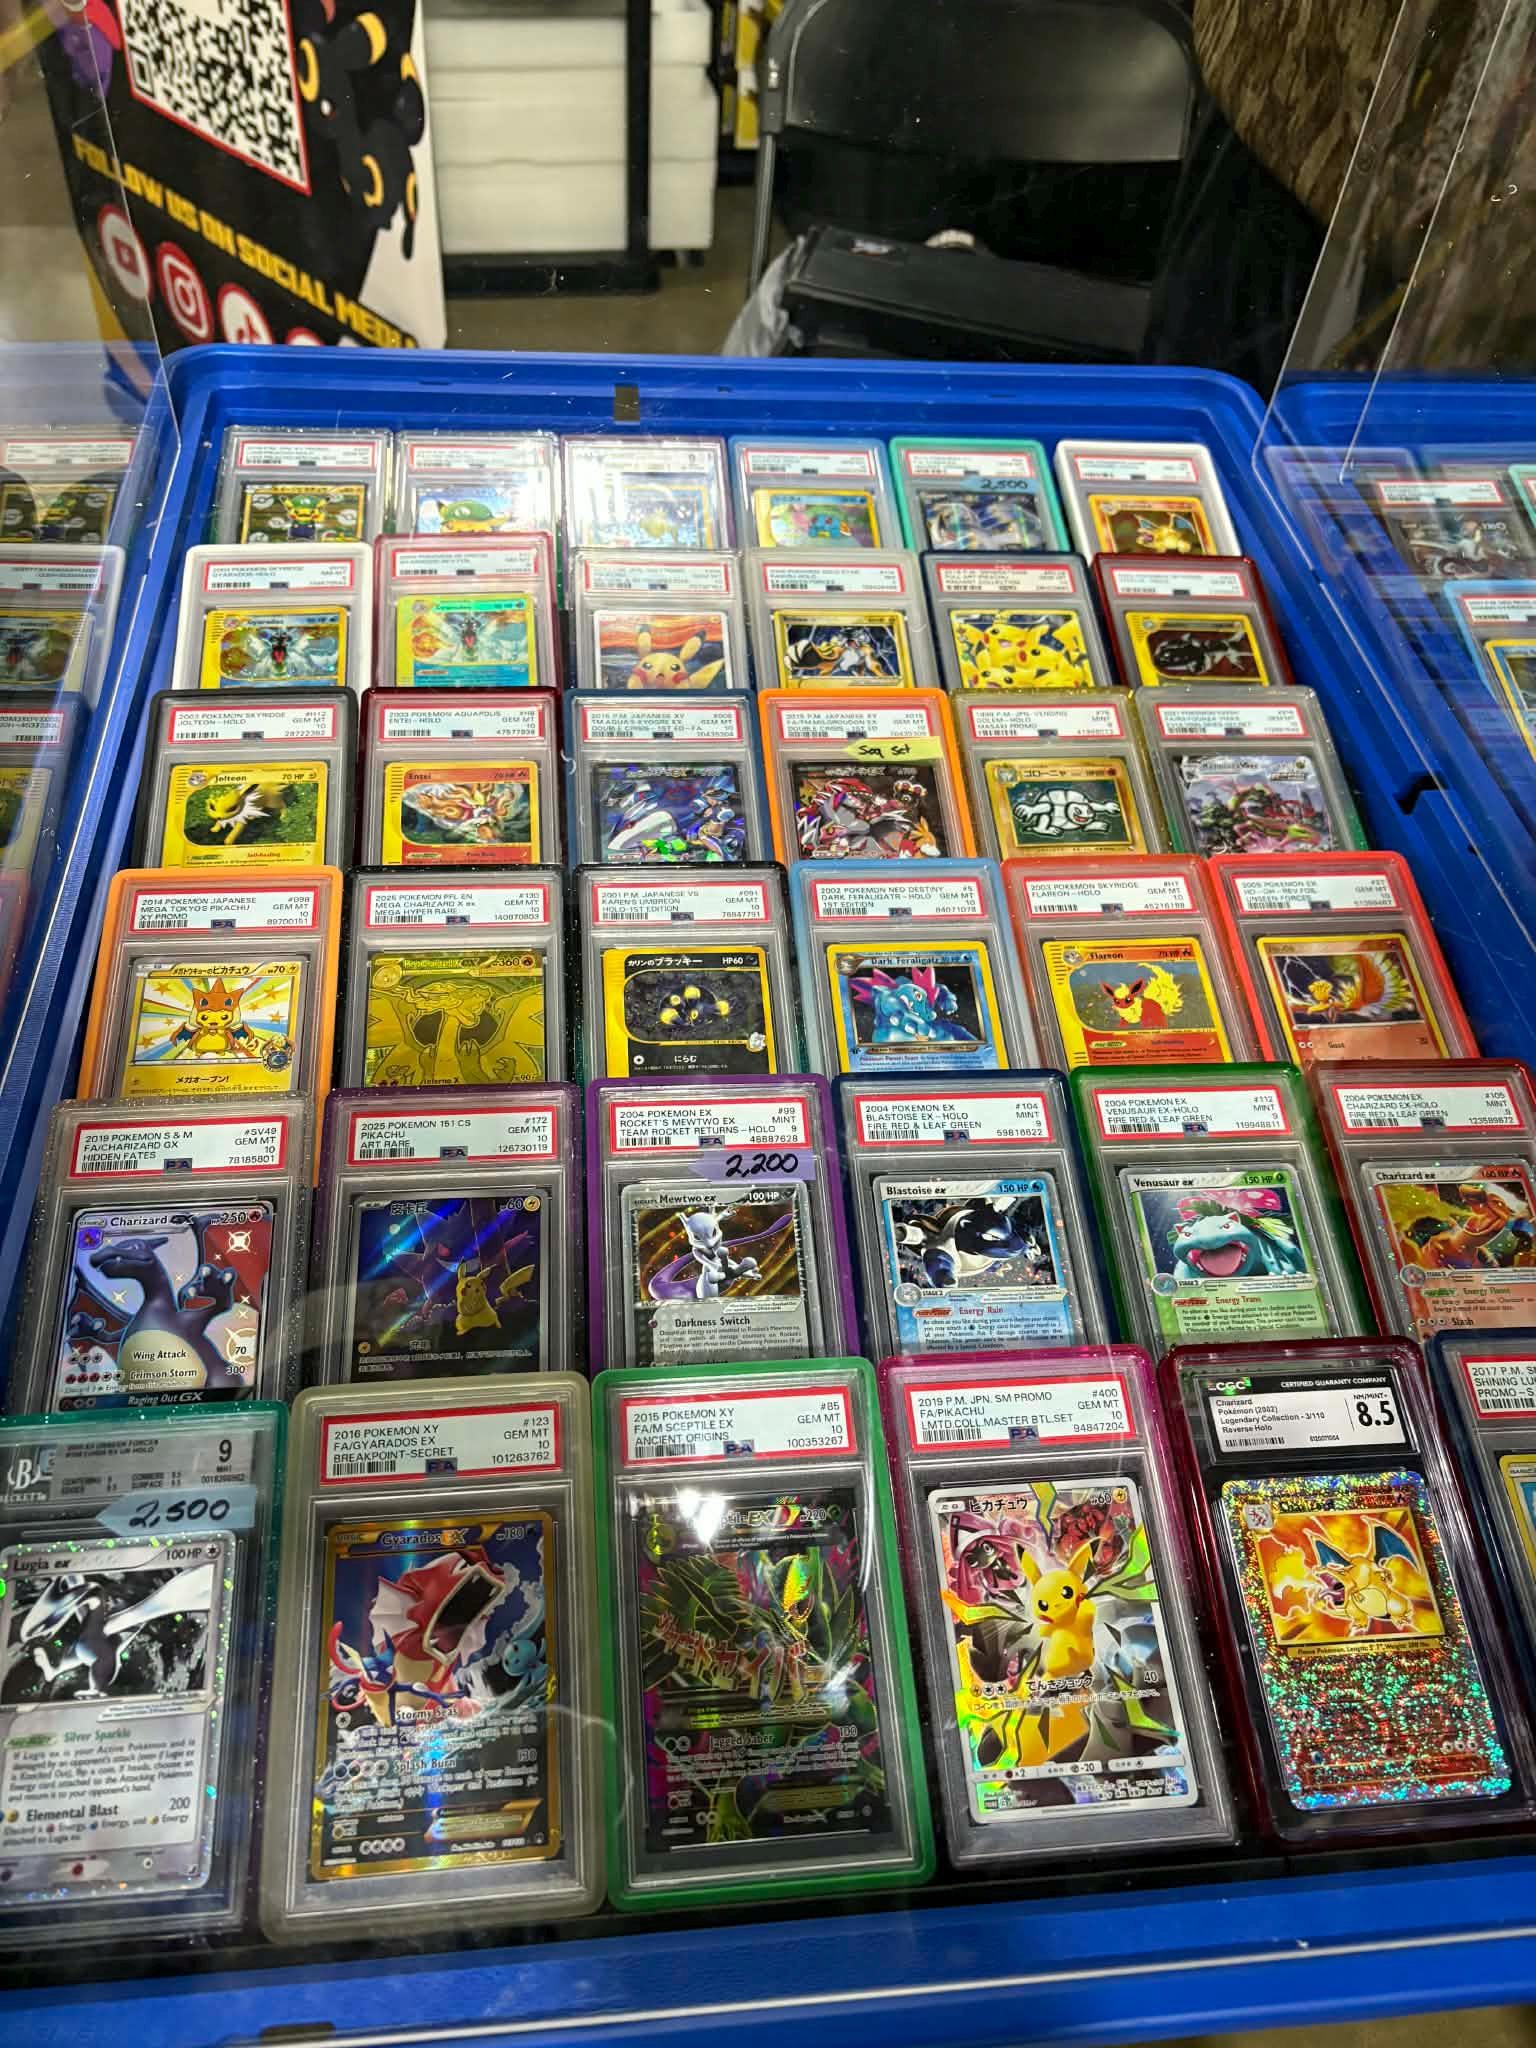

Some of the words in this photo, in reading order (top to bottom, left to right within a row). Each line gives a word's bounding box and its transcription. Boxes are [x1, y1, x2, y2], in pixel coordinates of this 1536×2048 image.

[71, 132, 164, 210] FOLLOW
[163, 191, 200, 234] US
[200, 210, 237, 258] ON
[238, 230, 335, 317] SOCIAL
[722, 957, 744, 965] HP60
[892, 1104, 940, 1112] POKEMON
[1105, 1100, 1126, 1108] 2004
[1128, 1098, 1174, 1106] POKEMON
[1346, 1102, 1398, 1110] CHARIZARD
[620, 1110, 645, 1119] 2004
[647, 1110, 696, 1118] POKEMON
[1106, 1107, 1156, 1115] VENUSAUR
[620, 1119, 669, 1127] ROCKET'S
[672, 1118, 720, 1126] MEWTWO
[723, 1117, 735, 1125] EX
[772, 1116, 796, 1124] MINT
[866, 1113, 918, 1121] BLASTOISE
[360, 1122, 385, 1131] 2025
[387, 1121, 437, 1130] POKEMON
[508, 1126, 531, 1134] GEM
[532, 1125, 548, 1133] MT
[923, 1121, 947, 1129] LEAF
[950, 1121, 982, 1129] GREEN
[360, 1130, 405, 1140] PIKACHU
[620, 1128, 649, 1136] TEAM
[651, 1127, 691, 1135] ROCKET
[85, 1134, 110, 1143] 2019
[112, 1133, 162, 1142] POKEMON
[235, 1138, 258, 1146] GEM
[84, 1141, 161, 1152] FA/CHARIZARD
[83, 1153, 122, 1162] HIDDEN
[123, 1151, 156, 1160] FATES
[725, 1153, 799, 1178] 2,200
[1375, 1172, 1422, 1181] Charizard
[1134, 1178, 1180, 1188] Venusaur
[886, 1186, 933, 1195] Blastoise
[659, 1194, 701, 1204] Mewtwo
[110, 1216, 169, 1227] Charizard
[221, 1212, 247, 1224] 250
[1215, 1296, 1240, 1305] Energy
[959, 1307, 984, 1317] Energy
[675, 1318, 717, 1328] Darkness
[720, 1317, 751, 1326] Switch
[133, 1350, 155, 1361] Wing
[157, 1349, 187, 1359] Attack
[169, 1368, 198, 1378] Storm
[1472, 1367, 1497, 1376] 2017
[1353, 1376, 1387, 1384] COMPANY
[1474, 1377, 1518, 1387] SHINING
[1092, 1388, 1118, 1398] #400
[1477, 1388, 1517, 1397] PROMO
[918, 1397, 943, 1407] 2019
[970, 1395, 992, 1405] JPN.
[995, 1393, 1012, 1403] SM
[1014, 1391, 1052, 1402] PROMO
[1077, 1400, 1102, 1410] GEM
[1103, 1399, 1120, 1408] MT
[633, 1412, 660, 1423] 2015
[662, 1409, 717, 1422] POKEMON
[719, 1408, 735, 1417] XY
[920, 1406, 985, 1418] FA/PIKACHU
[1112, 1411, 1123, 1420] 10
[1356, 1401, 1395, 1427] 8.5
[523, 1417, 550, 1426] #123
[797, 1414, 822, 1424] GEM
[824, 1413, 841, 1423] MT
[1221, 1416, 1260, 1426] Legendary
[1261, 1413, 1300, 1423] Collection
[634, 1424, 663, 1434] FA/M
[665, 1421, 717, 1432] SCEPTILE
[719, 1419, 734, 1429] EX
[831, 1425, 843, 1434] 10
[1222, 1425, 1253, 1434] Reverse
[1255, 1424, 1273, 1432] Holo
[334, 1429, 361, 1440] 2016
[364, 1426, 420, 1438] POKEMON
[423, 1424, 439, 1434] XY
[503, 1429, 529, 1440] GEM
[531, 1428, 549, 1438] MT
[334, 1437, 418, 1451] FA/GYARADOS
[420, 1435, 436, 1445] EX
[635, 1434, 683, 1446] ANCIENT
[685, 1432, 729, 1443] ORIGINS
[538, 1440, 550, 1449] 10
[218, 1439, 233, 1463] 9
[333, 1446, 455, 1464] BREAKPOINT-SECRET
[969, 1497, 1028, 1513] ピカチュウ
[128, 1498, 231, 1528] 2,500
[14, 1558, 49, 1572] Lugia
[1143, 1671, 1158, 1683] 40
[395, 1709, 433, 1725] Stormy
[63, 1730, 92, 1742] Silver
[95, 1728, 131, 1741] Sparkle
[169, 1797, 191, 1810] 200
[27, 1806, 85, 1822] Elemental
[89, 1804, 119, 1816] Blast
